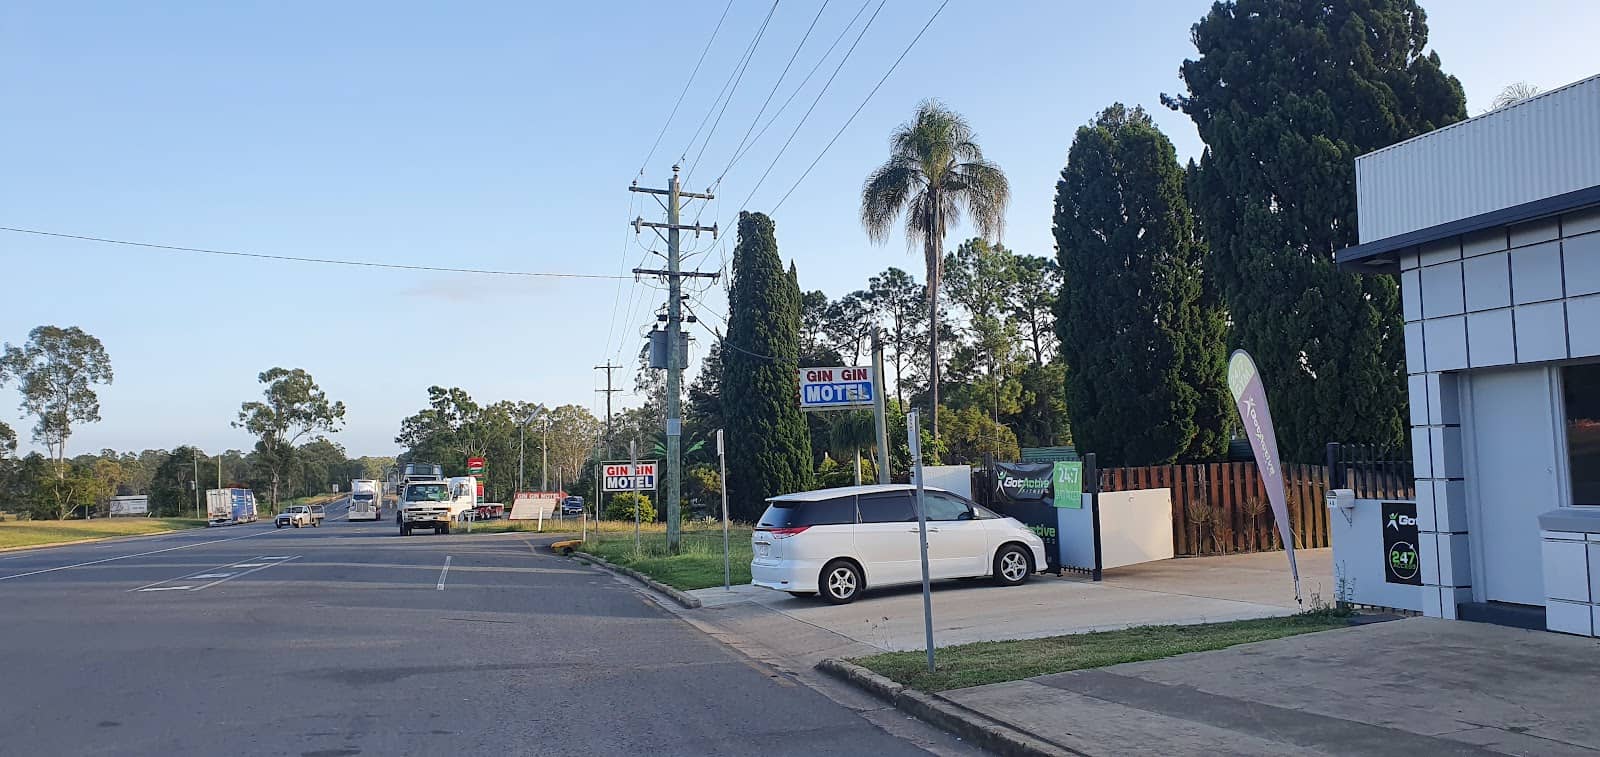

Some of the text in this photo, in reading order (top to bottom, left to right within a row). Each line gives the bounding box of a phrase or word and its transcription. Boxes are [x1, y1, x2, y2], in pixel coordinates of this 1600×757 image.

[806, 368, 868, 382] GIN GIN
[806, 384, 870, 402] MOTEL
[606, 466, 628, 476] GIN
[607, 476, 653, 489] MOTEL
[1391, 550, 1415, 565] 247
